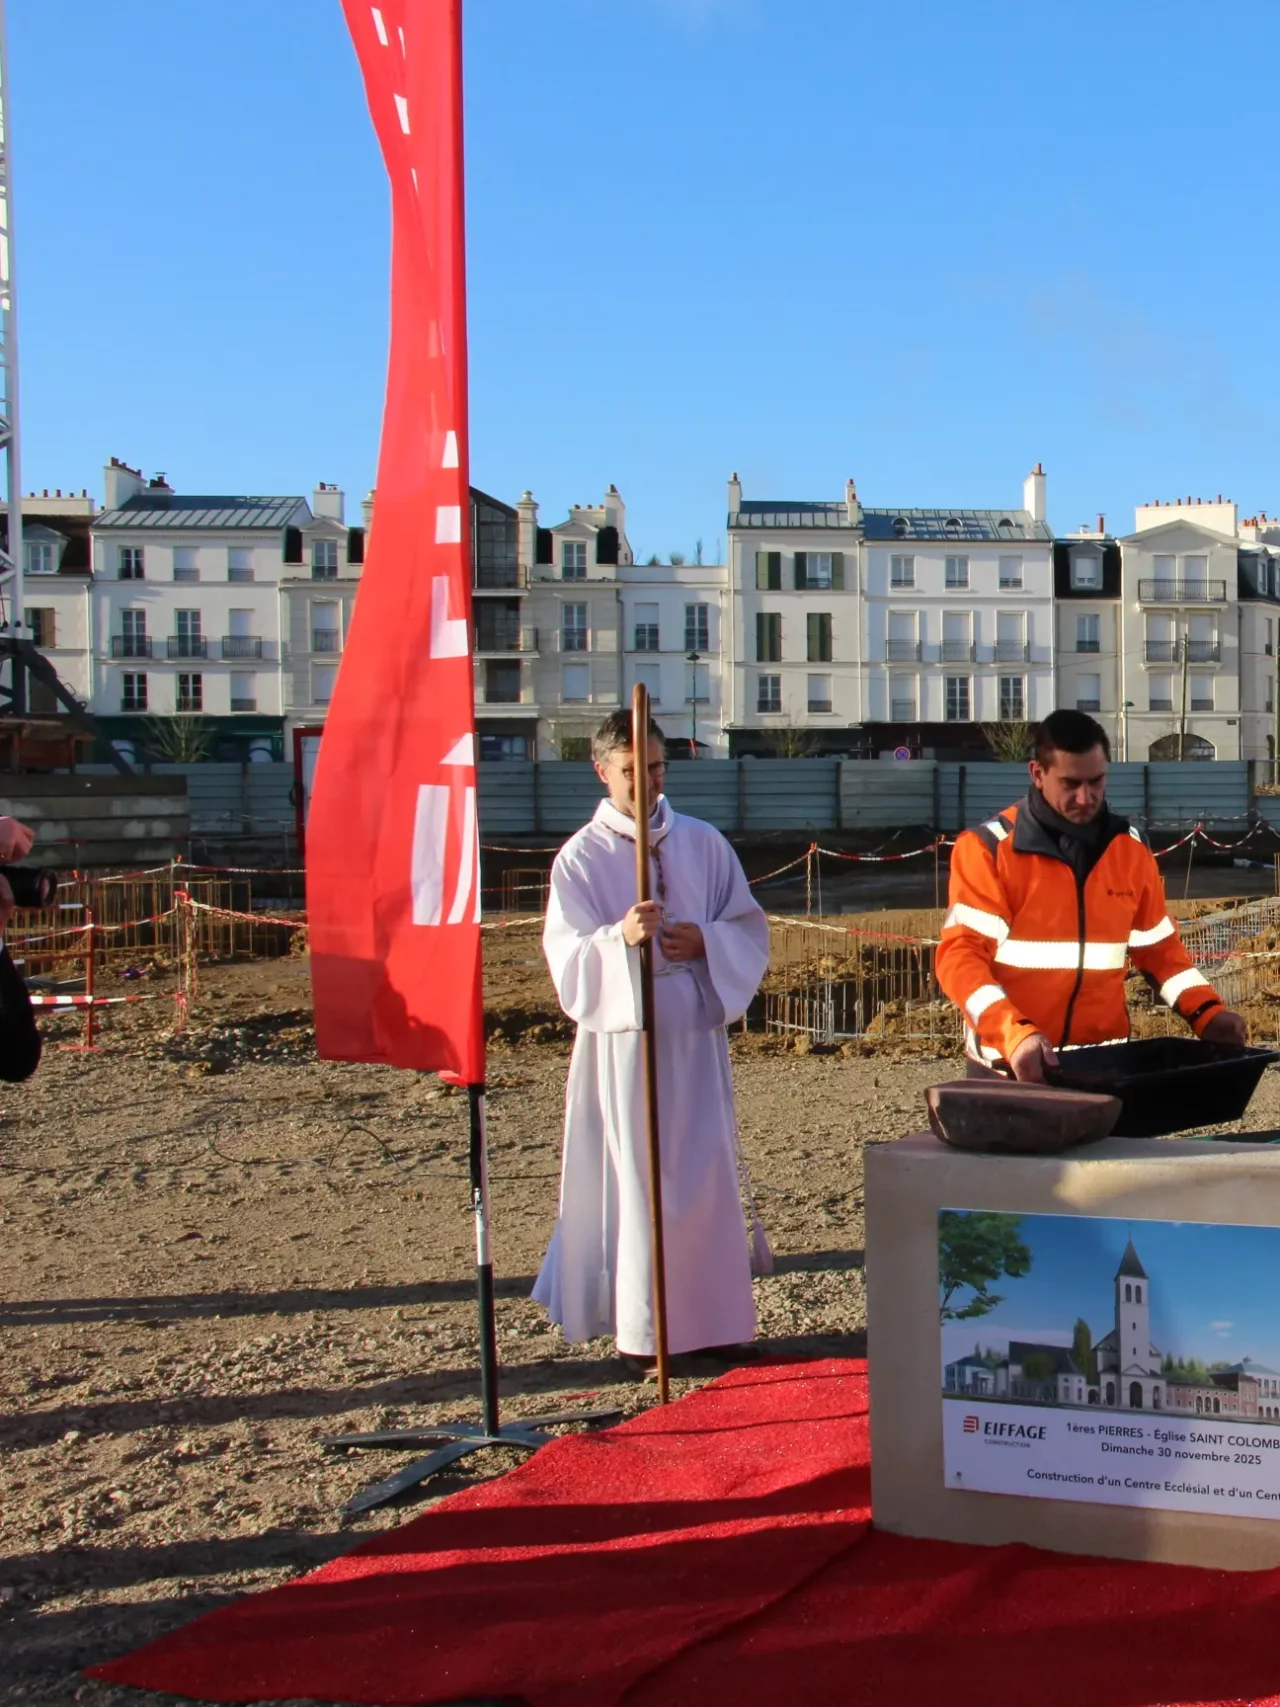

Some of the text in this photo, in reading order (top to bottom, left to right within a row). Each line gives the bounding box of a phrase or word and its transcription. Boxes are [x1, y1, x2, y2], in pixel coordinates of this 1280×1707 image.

[984, 1421, 1047, 1440] EIFFAGE
[1066, 1422, 1095, 1434] 1ères
[1098, 1425, 1144, 1438] PIERRES
[1153, 1429, 1186, 1443] Église
[1189, 1432, 1225, 1446] SAINT
[1101, 1442, 1262, 1465] Dimanche 30 novembre 2025
[1026, 1468, 1094, 1485] Construction
[1097, 1474, 1121, 1487] d'un
[1124, 1477, 1161, 1491] Centre
[1164, 1481, 1210, 1495] Ecclésial
[1213, 1487, 1225, 1497] et
[1228, 1487, 1252, 1499] d'un
